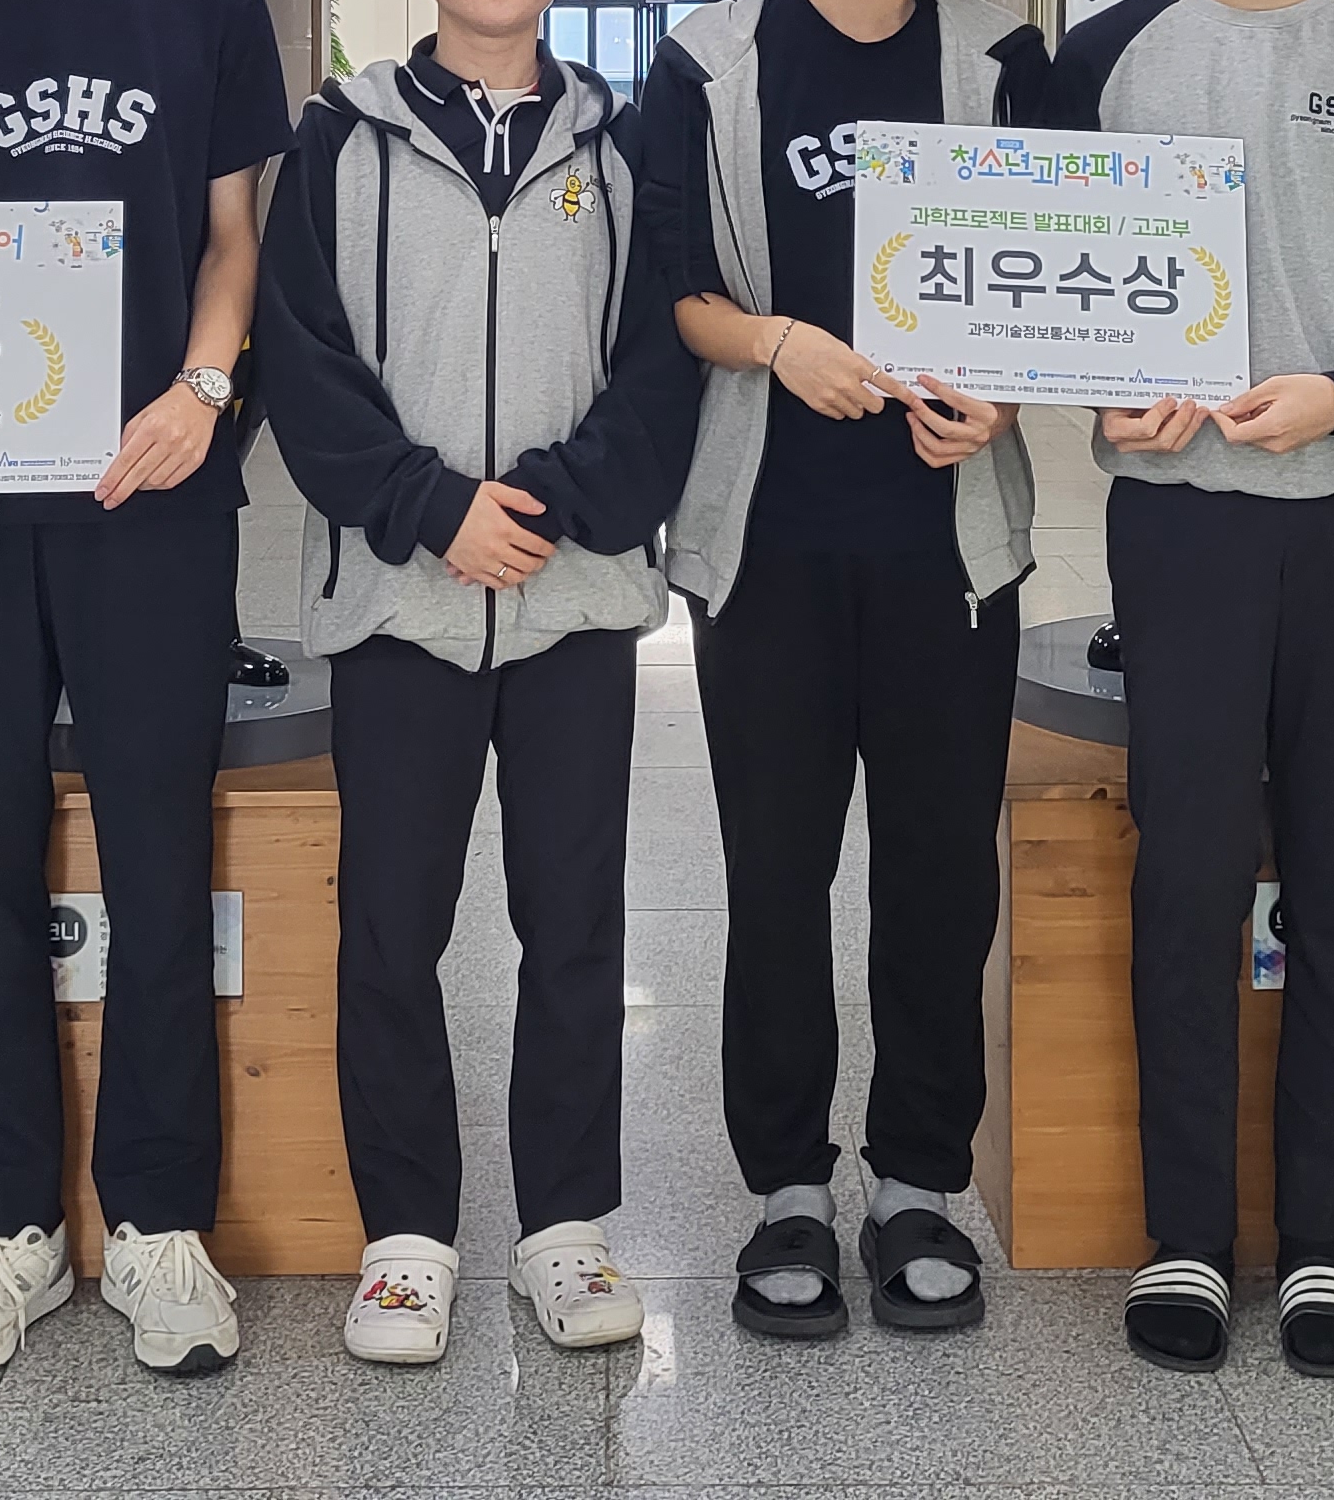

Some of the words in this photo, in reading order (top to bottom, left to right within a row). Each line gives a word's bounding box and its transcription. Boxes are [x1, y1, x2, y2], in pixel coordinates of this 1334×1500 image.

[950, 144, 1150, 188] 청소년과학페어
[910, 207, 1028, 231] 과학프로젝트
[1034, 212, 1111, 235] 발표대회
[1132, 218, 1191, 239] 고교부
[918, 245, 1185, 316] 최우수상
[968, 323, 1090, 341] 과학기술정보통신부
[1094, 327, 1135, 343] 장관상
